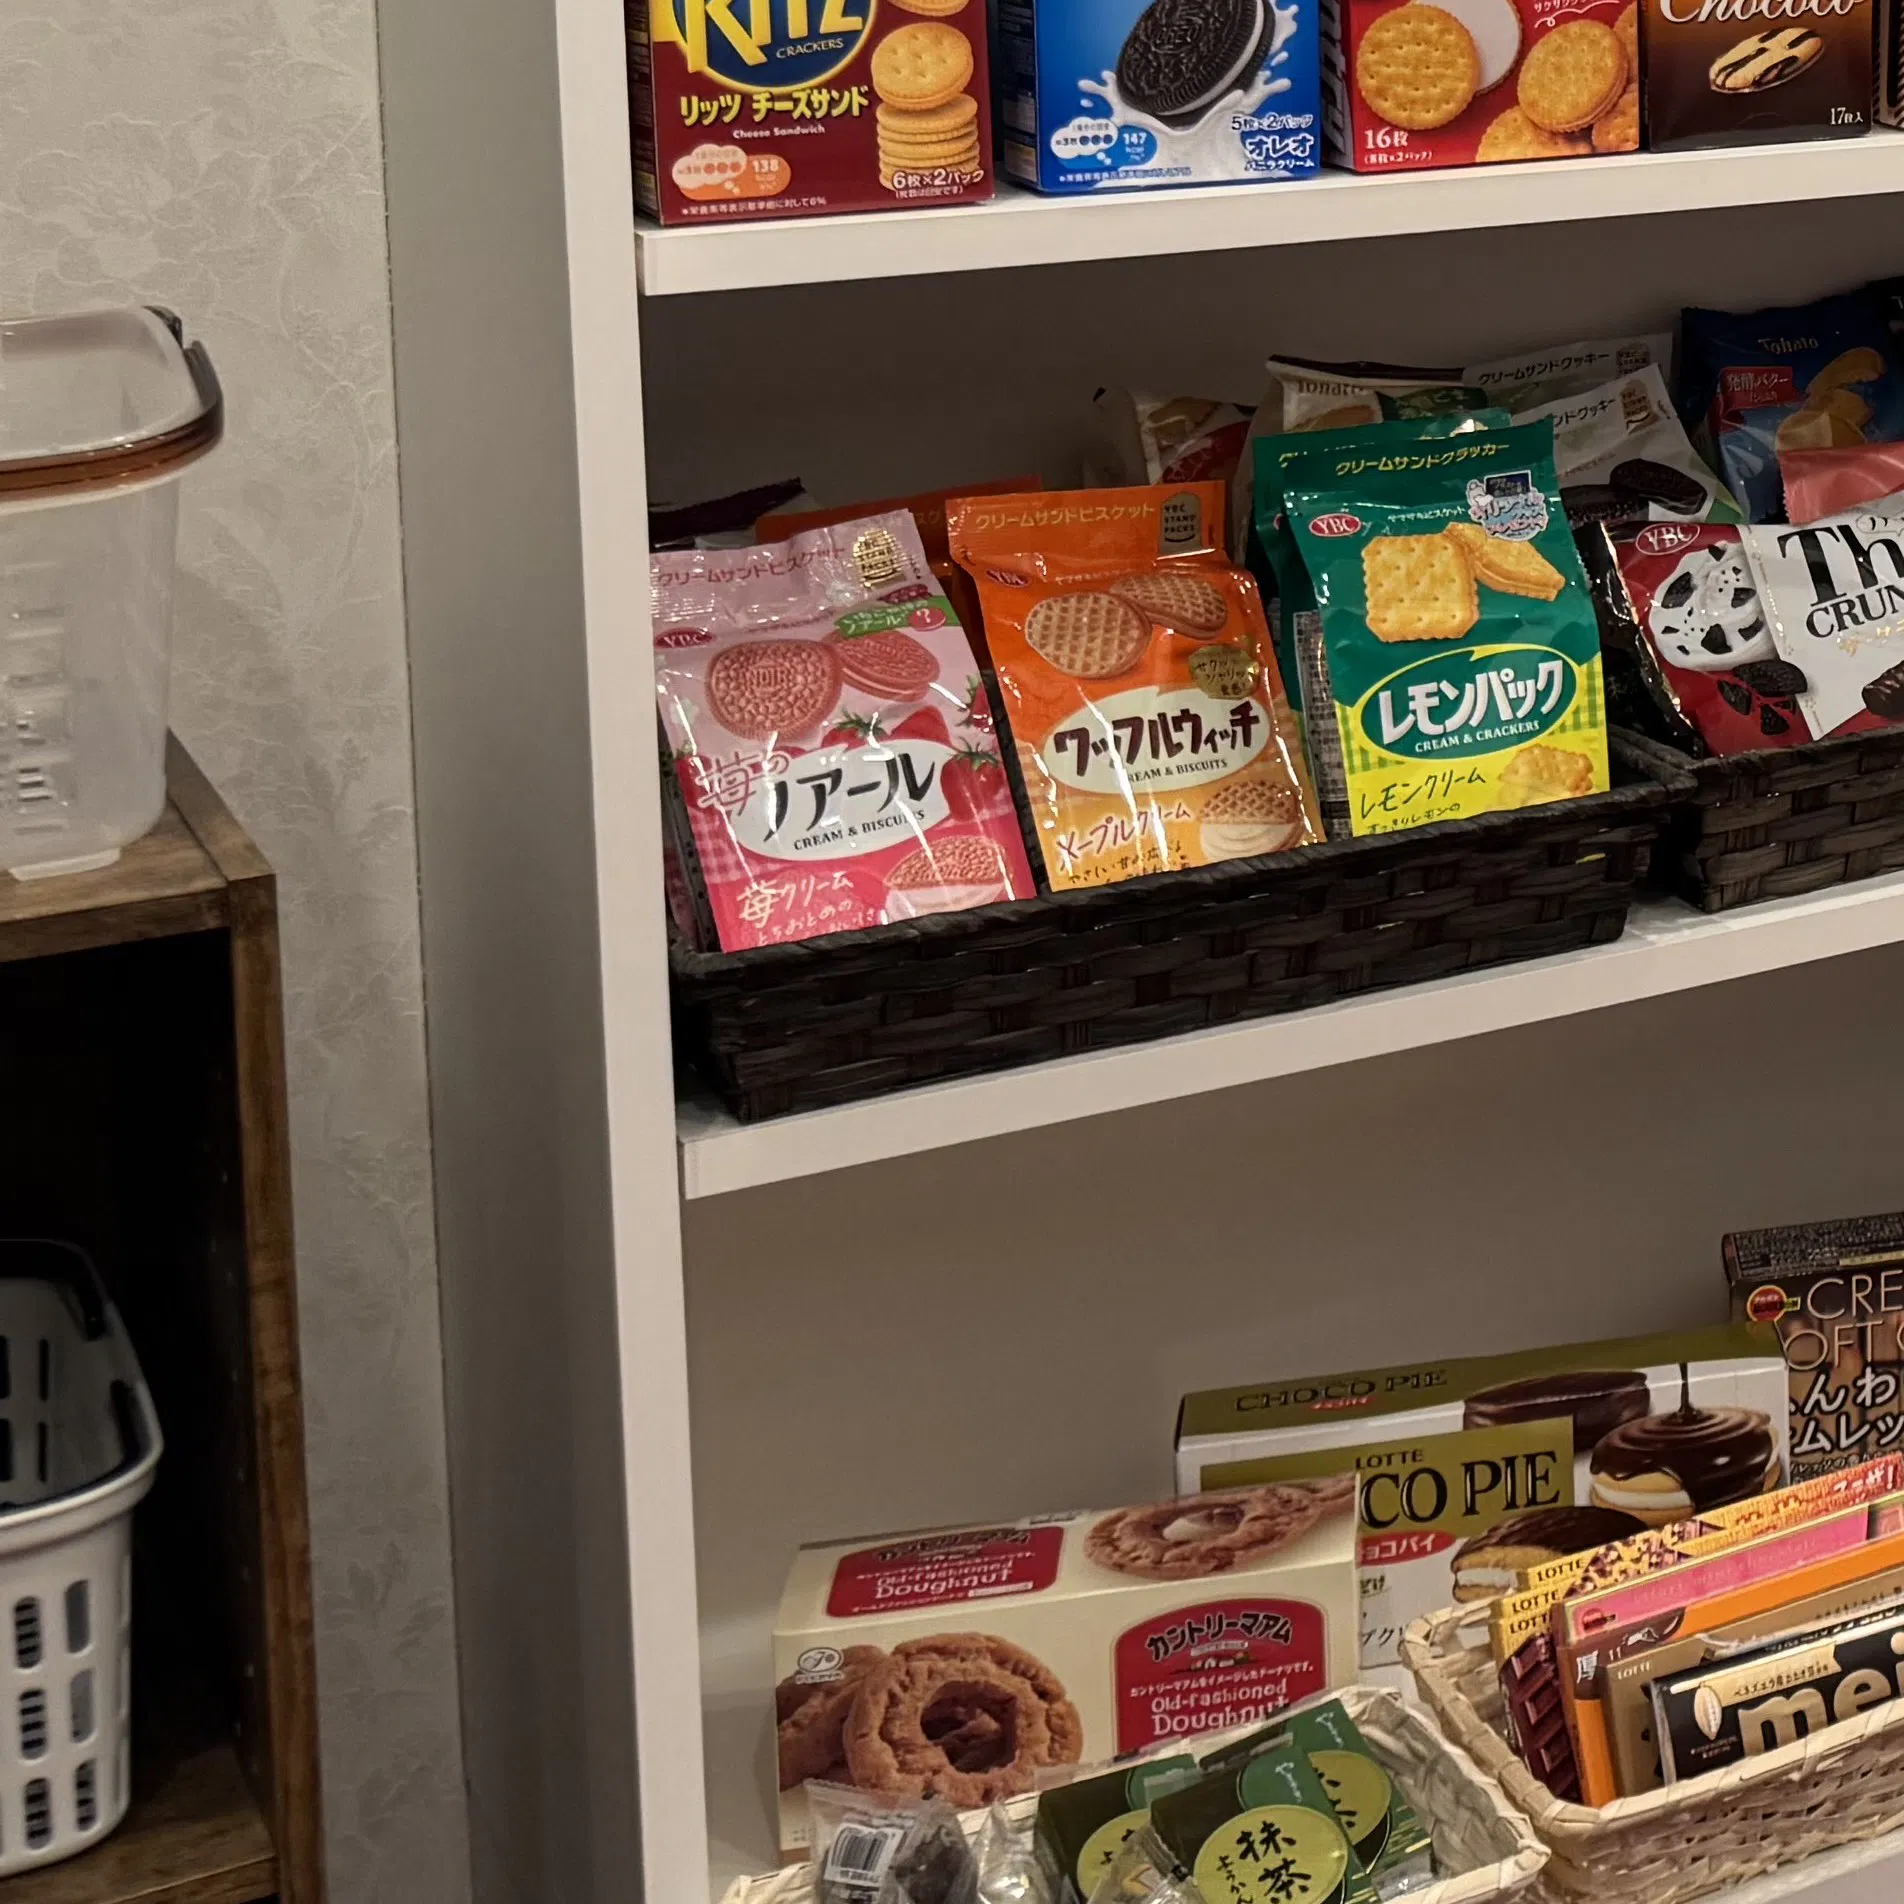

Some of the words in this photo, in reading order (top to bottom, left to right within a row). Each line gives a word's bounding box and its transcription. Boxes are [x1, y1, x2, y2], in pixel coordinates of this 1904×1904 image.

[776, 38, 844, 59] CRACKERS
[680, 94, 740, 126] リッツ
[752, 87, 871, 122] チーズサンド
[732, 128, 770, 139] Cheese
[773, 125, 825, 137] Sandwich
[1758, 335, 1819, 355] Tohato
[974, 502, 1156, 530] クリームサンドビスケット
[1314, 516, 1355, 534] YBC
[1378, 659, 1564, 744] レモンパック
[1052, 699, 1261, 778] ワッフルウィッチ
[1414, 735, 1458, 753] CREAM
[1462, 732, 1472, 745] &
[1476, 719, 1540, 741] CRACKERS
[1359, 766, 1487, 820] レモンクリーム
[1463, 1452, 1562, 1516] PIE
[1148, 1613, 1295, 1661] カントリーマアム
